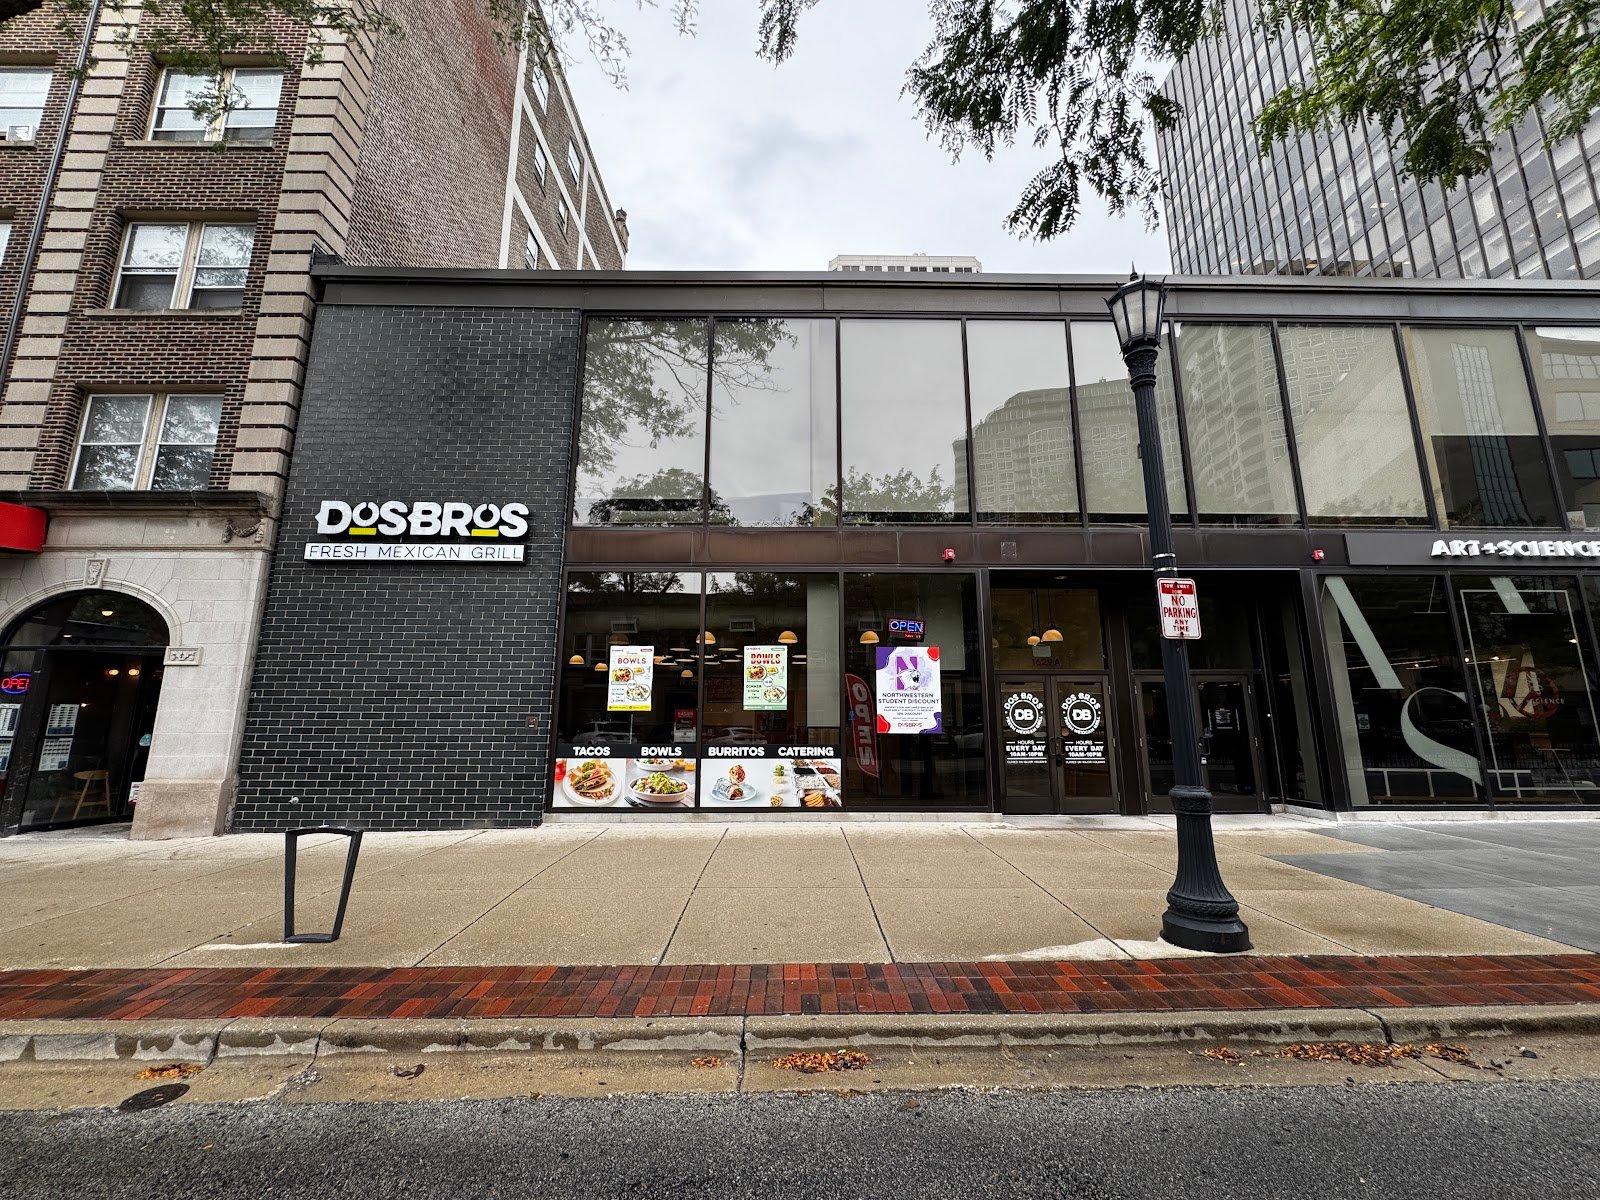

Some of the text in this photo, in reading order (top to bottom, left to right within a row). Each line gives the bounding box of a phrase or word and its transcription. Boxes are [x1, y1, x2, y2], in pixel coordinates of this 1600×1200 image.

[315, 500, 530, 538] DOSBROS
[309, 545, 522, 559] FRESH MEXICAN GRILL
[1171, 595, 1186, 606] NO
[1163, 607, 1196, 618] PARKING
[890, 620, 922, 632] OPEN
[617, 657, 647, 665] BOWLS
[750, 653, 781, 664] BOWLS
[1004, 692, 1044, 710] DOS BROS
[1061, 692, 1101, 710] DOS BROS
[1014, 709, 1034, 720] DB
[1072, 709, 1092, 720] DB
[573, 746, 682, 756] TACOS BOWLS
[708, 746, 834, 757] BURRITOS CATERING
